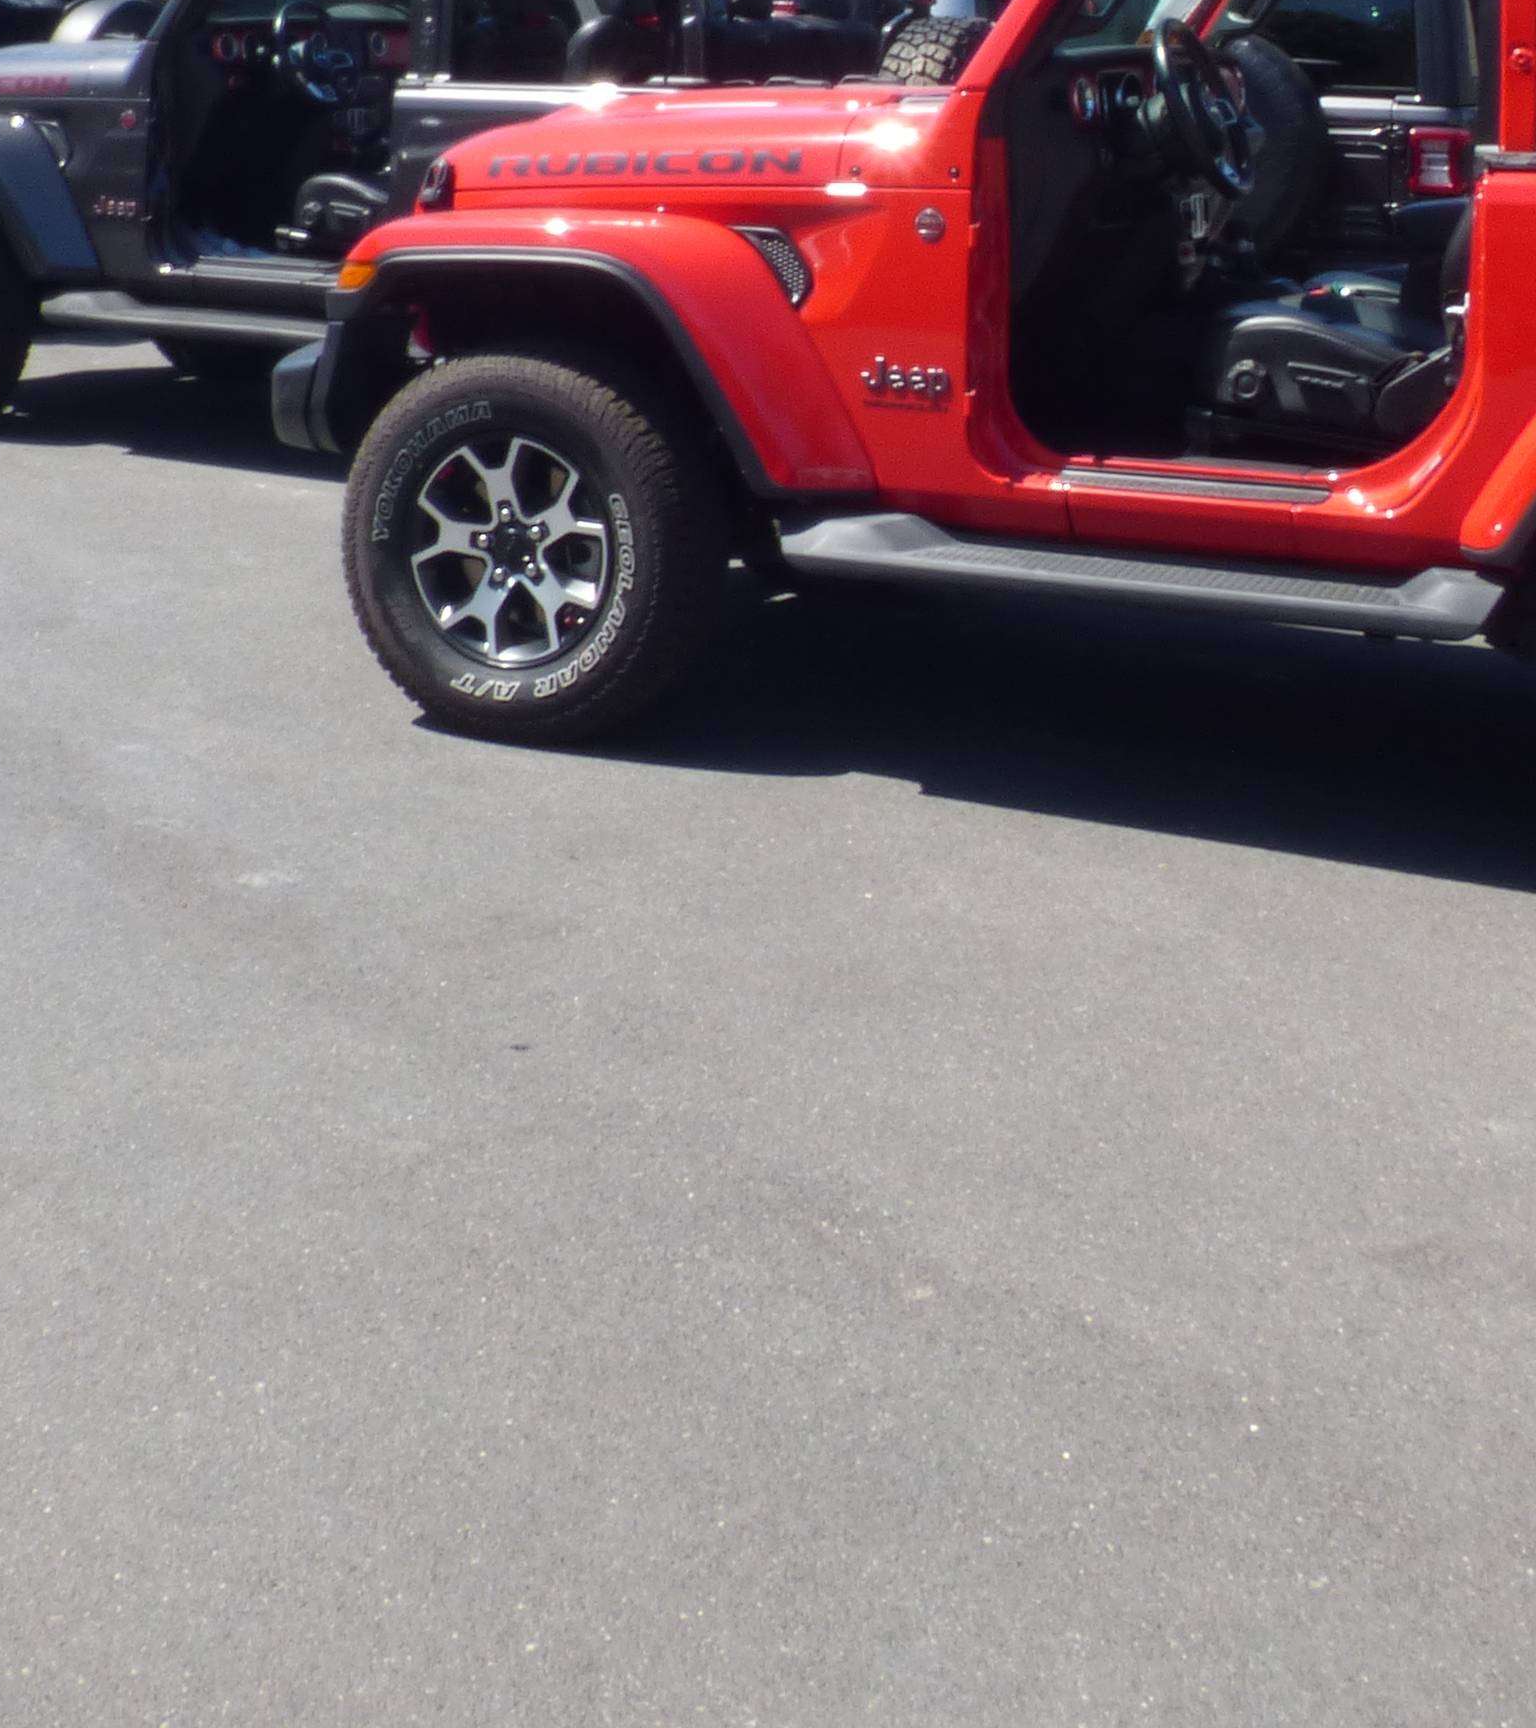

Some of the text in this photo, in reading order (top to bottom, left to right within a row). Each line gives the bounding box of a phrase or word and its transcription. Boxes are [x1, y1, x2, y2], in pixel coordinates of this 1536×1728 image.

[487, 149, 802, 178] RUBICON
[860, 355, 952, 402] Jeep
[372, 400, 493, 543] YOKOHAMA
[449, 492, 635, 701] GEOLANDAR A/T
